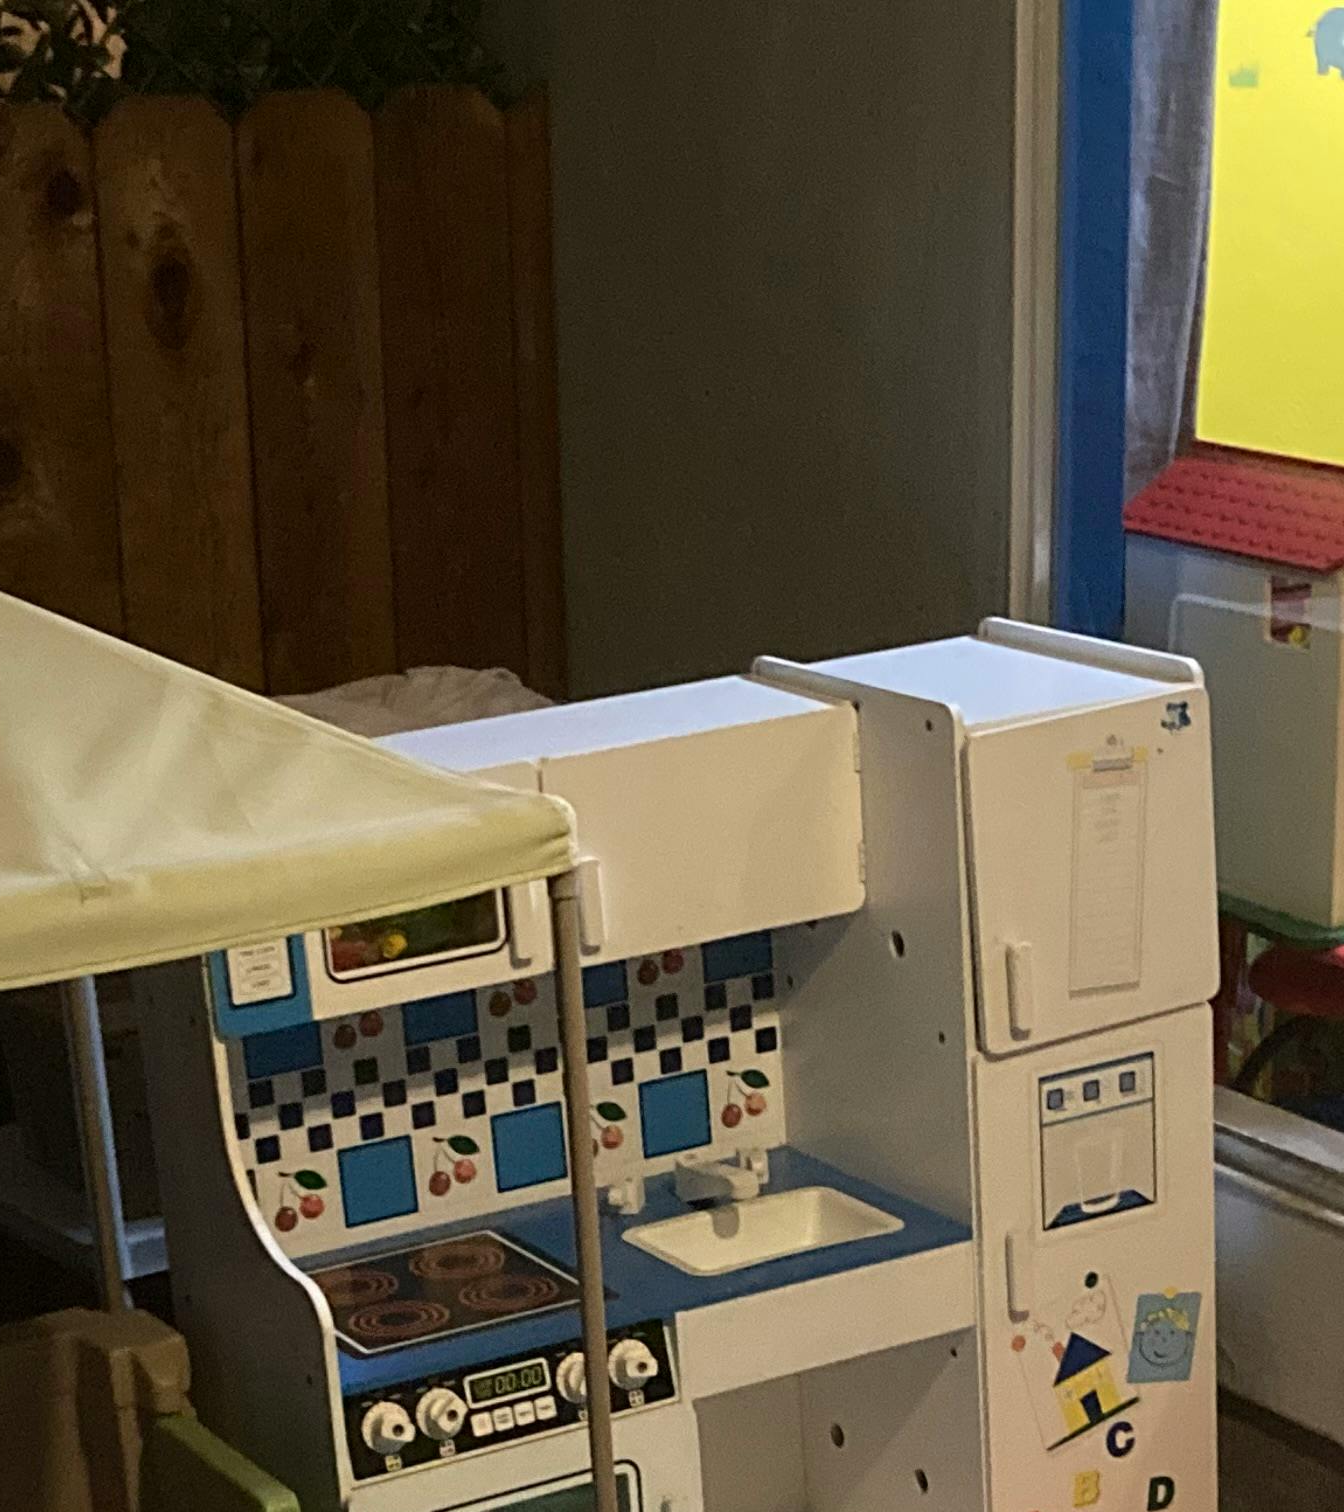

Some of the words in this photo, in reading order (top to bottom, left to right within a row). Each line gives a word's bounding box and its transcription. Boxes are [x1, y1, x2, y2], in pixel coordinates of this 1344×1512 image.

[1106, 1421, 1135, 1458] C
[1074, 1470, 1100, 1508] B
[1147, 1475, 1175, 1512] D
